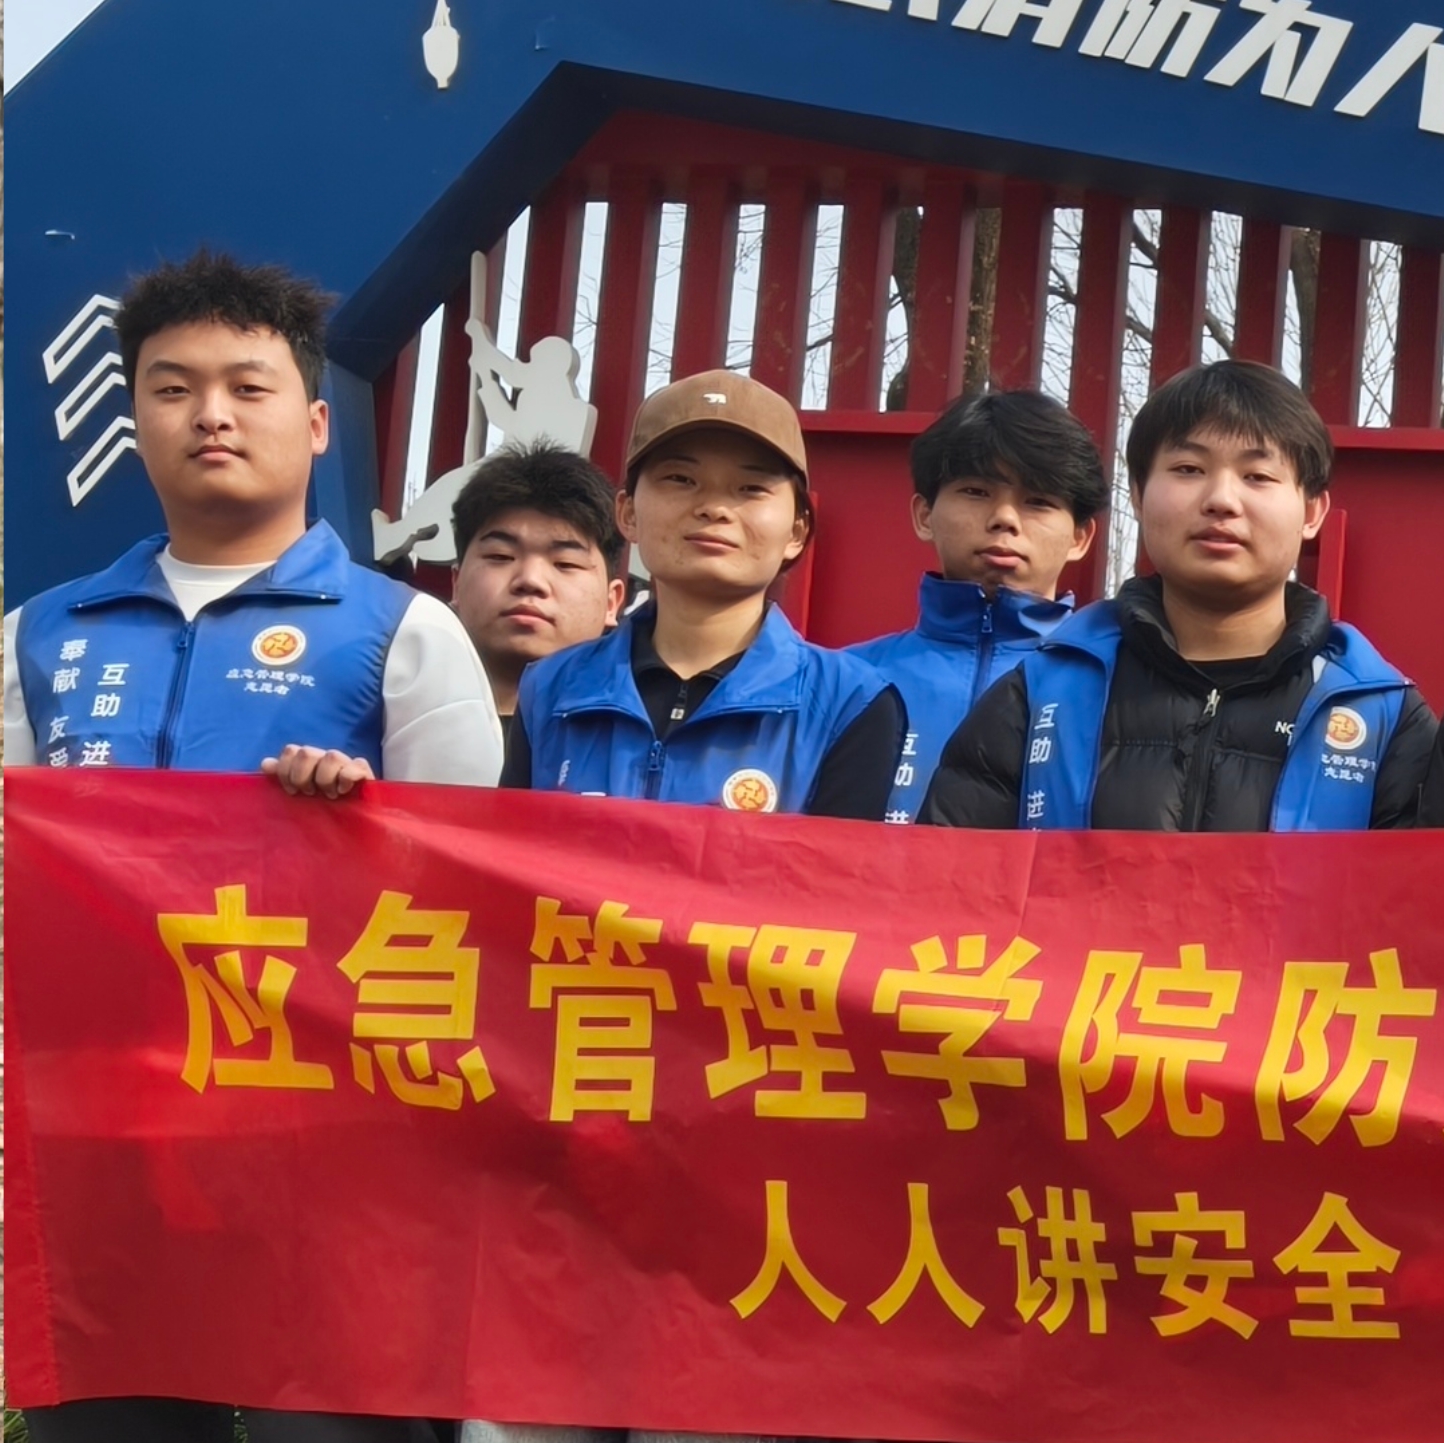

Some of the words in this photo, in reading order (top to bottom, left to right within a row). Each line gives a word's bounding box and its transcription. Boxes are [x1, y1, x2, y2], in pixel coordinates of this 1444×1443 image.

[48, 638, 89, 694] 奉献
[90, 663, 130, 718] 互助
[1028, 703, 1058, 764] 互助
[731, 1178, 1402, 1340] 人人讲安全
